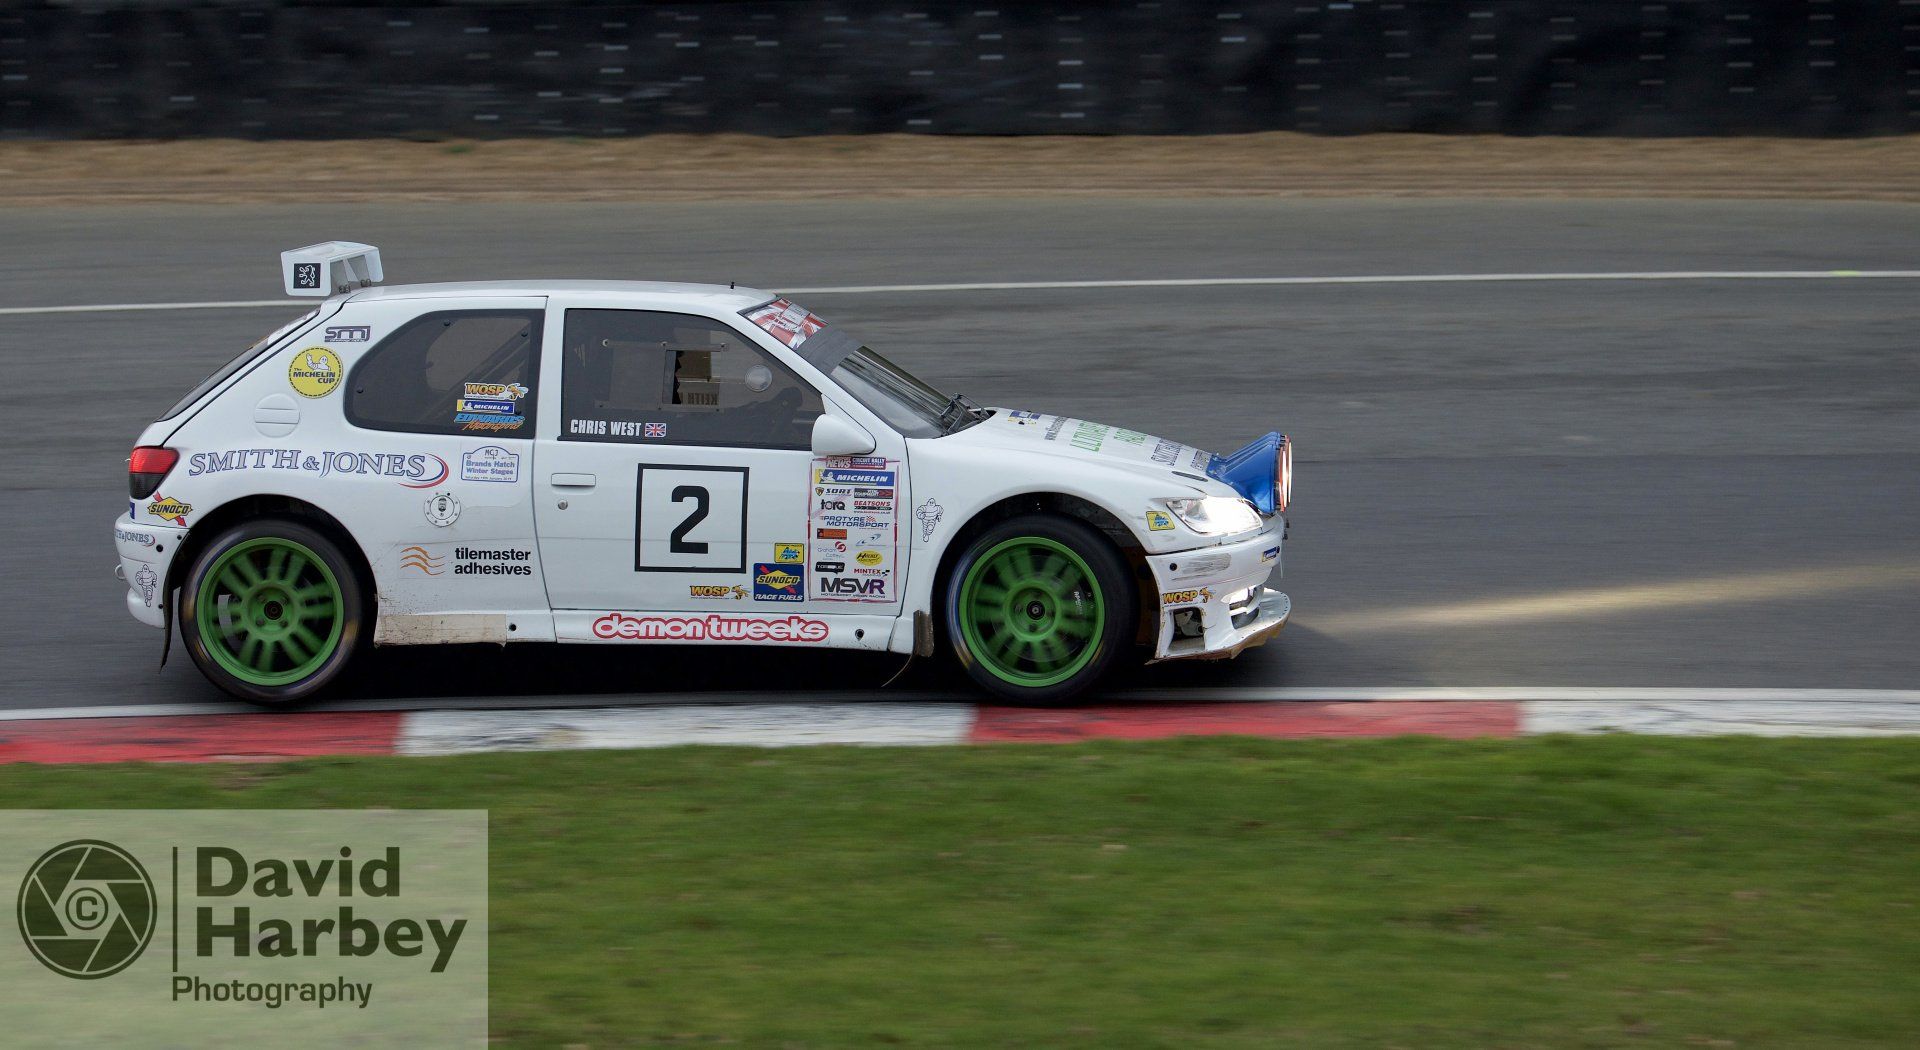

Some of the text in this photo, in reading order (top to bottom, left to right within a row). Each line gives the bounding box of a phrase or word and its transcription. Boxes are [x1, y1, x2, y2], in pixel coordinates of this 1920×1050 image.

[466, 384, 506, 396] WOSP
[570, 420, 642, 436] CHRIS WEST
[188, 449, 301, 476] SMITH
[320, 452, 426, 478] JONES
[826, 459, 851, 468] NEWS
[150, 505, 190, 514] SUNOCO
[670, 485, 710, 554] 2
[455, 548, 531, 560] tilemaster
[454, 562, 532, 575] adhesives
[758, 575, 799, 584] SUNOCO
[821, 577, 885, 594] MSVR
[690, 586, 730, 596] WOSP
[1162, 590, 1198, 604] WOSP
[594, 614, 829, 641] demon tweeks
